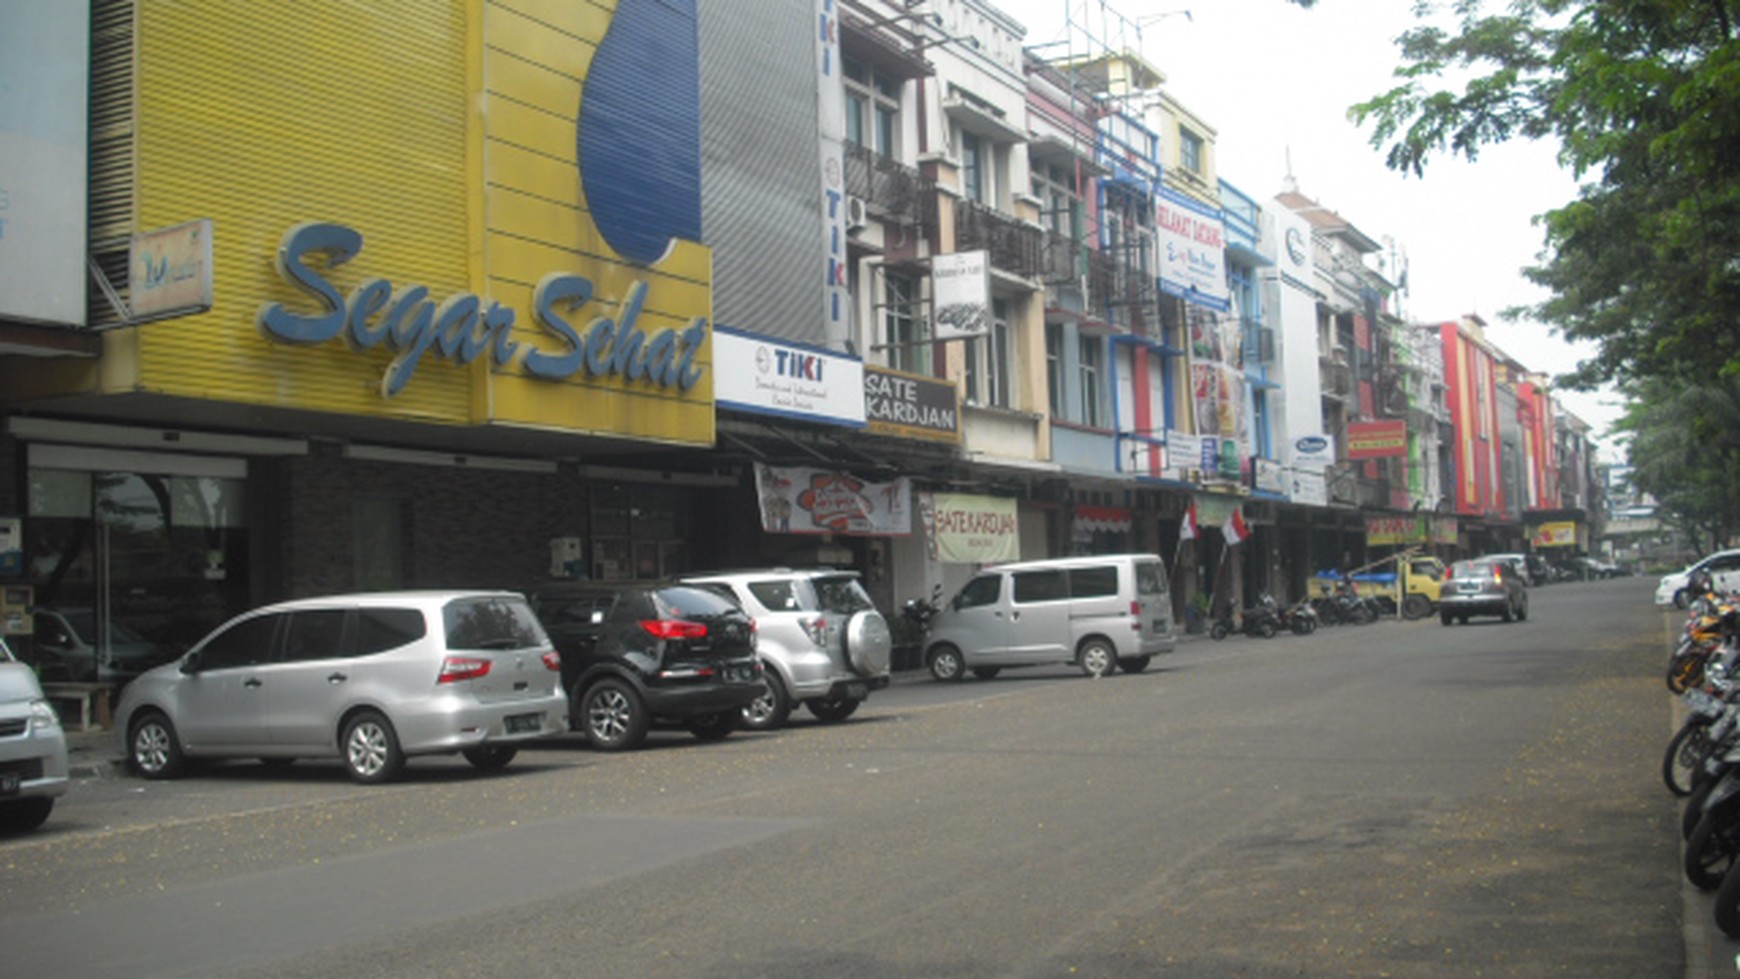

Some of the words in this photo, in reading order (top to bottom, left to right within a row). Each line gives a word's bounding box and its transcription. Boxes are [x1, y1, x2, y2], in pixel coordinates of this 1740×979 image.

[827, 188, 843, 321] TIKI
[256, 222, 519, 398] Segar
[516, 272, 707, 391] Sehat
[864, 374, 917, 402] SATE
[864, 396, 954, 429] KARDJAN
